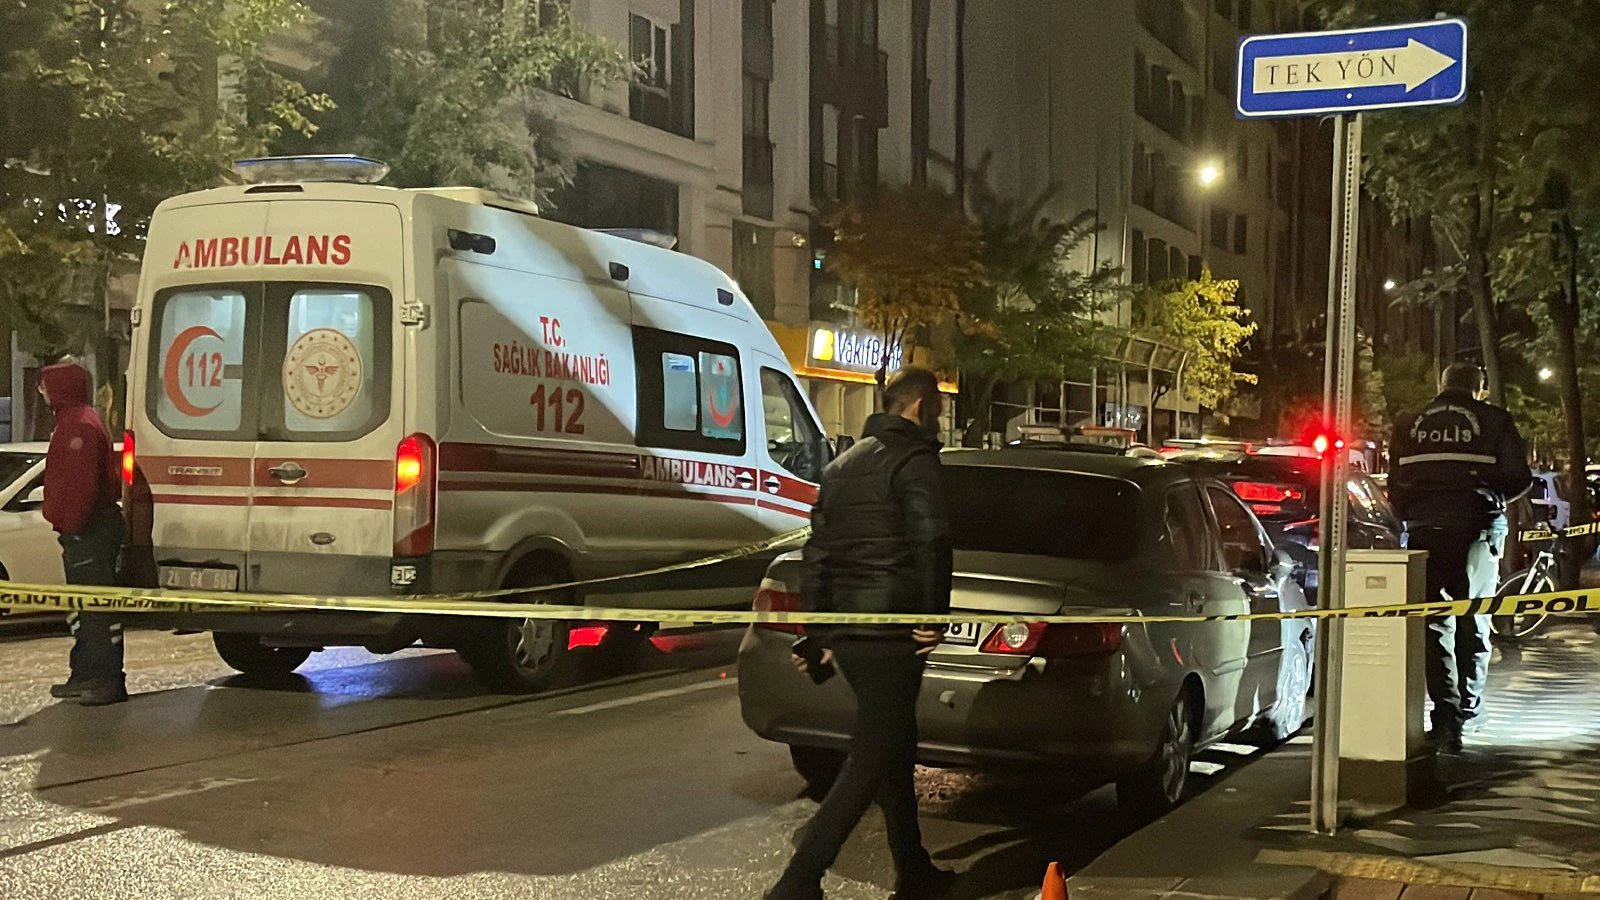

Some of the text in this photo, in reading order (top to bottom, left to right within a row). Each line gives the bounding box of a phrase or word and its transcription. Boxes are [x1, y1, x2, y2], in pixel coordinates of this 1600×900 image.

[1265, 53, 1397, 86] TEK YÖN
[173, 234, 352, 270] AMBULANS
[539, 316, 566, 347] T.C.
[186, 352, 222, 387] 112
[493, 341, 610, 386] SAĞLIK BAKANLIĞI
[530, 383, 585, 435] 112
[642, 456, 737, 488] AMBULANS
